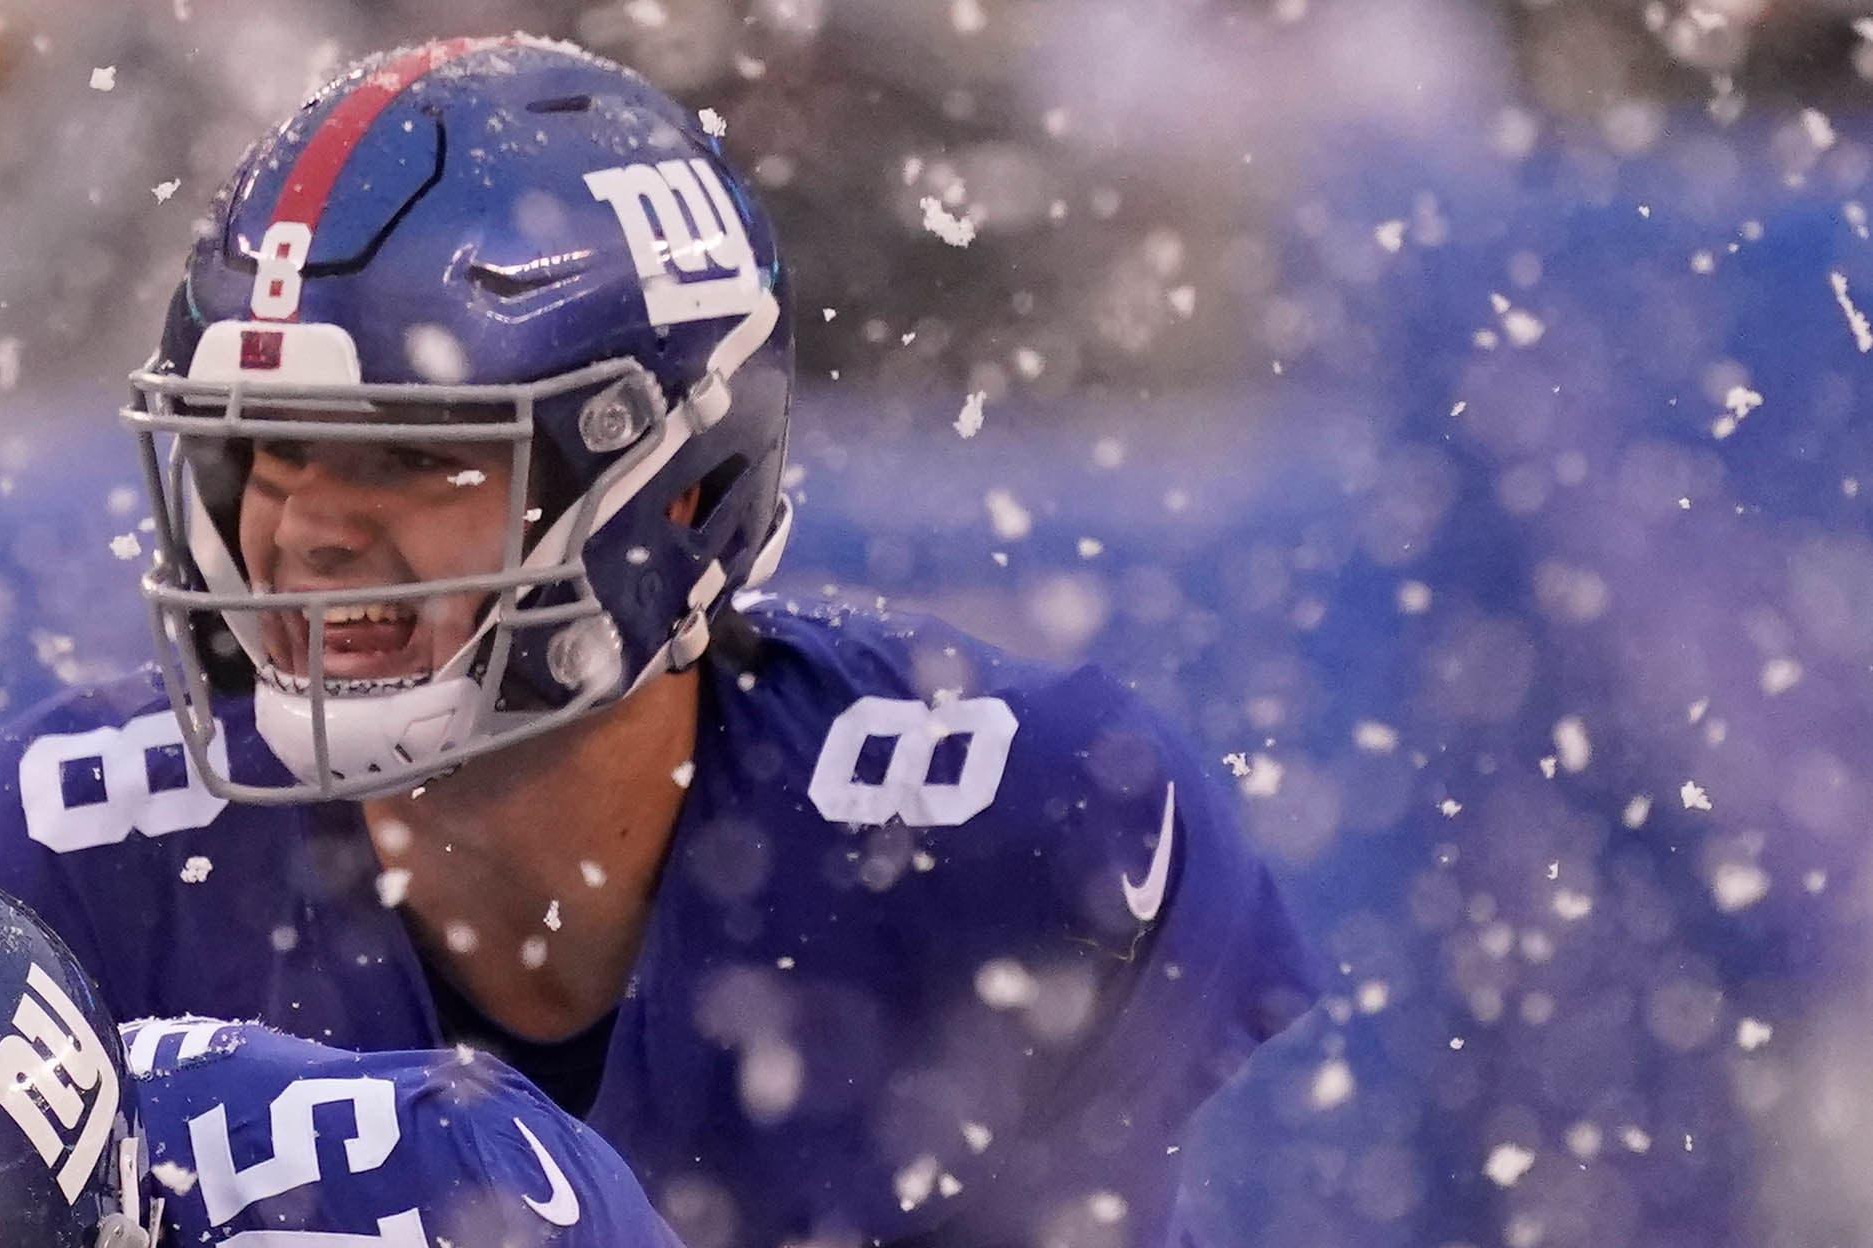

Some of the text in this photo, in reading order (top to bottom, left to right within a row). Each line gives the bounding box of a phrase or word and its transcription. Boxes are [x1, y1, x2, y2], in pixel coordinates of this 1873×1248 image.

[249, 221, 313, 320] 8
[19, 709, 230, 854] 8
[807, 697, 1019, 826] 8
